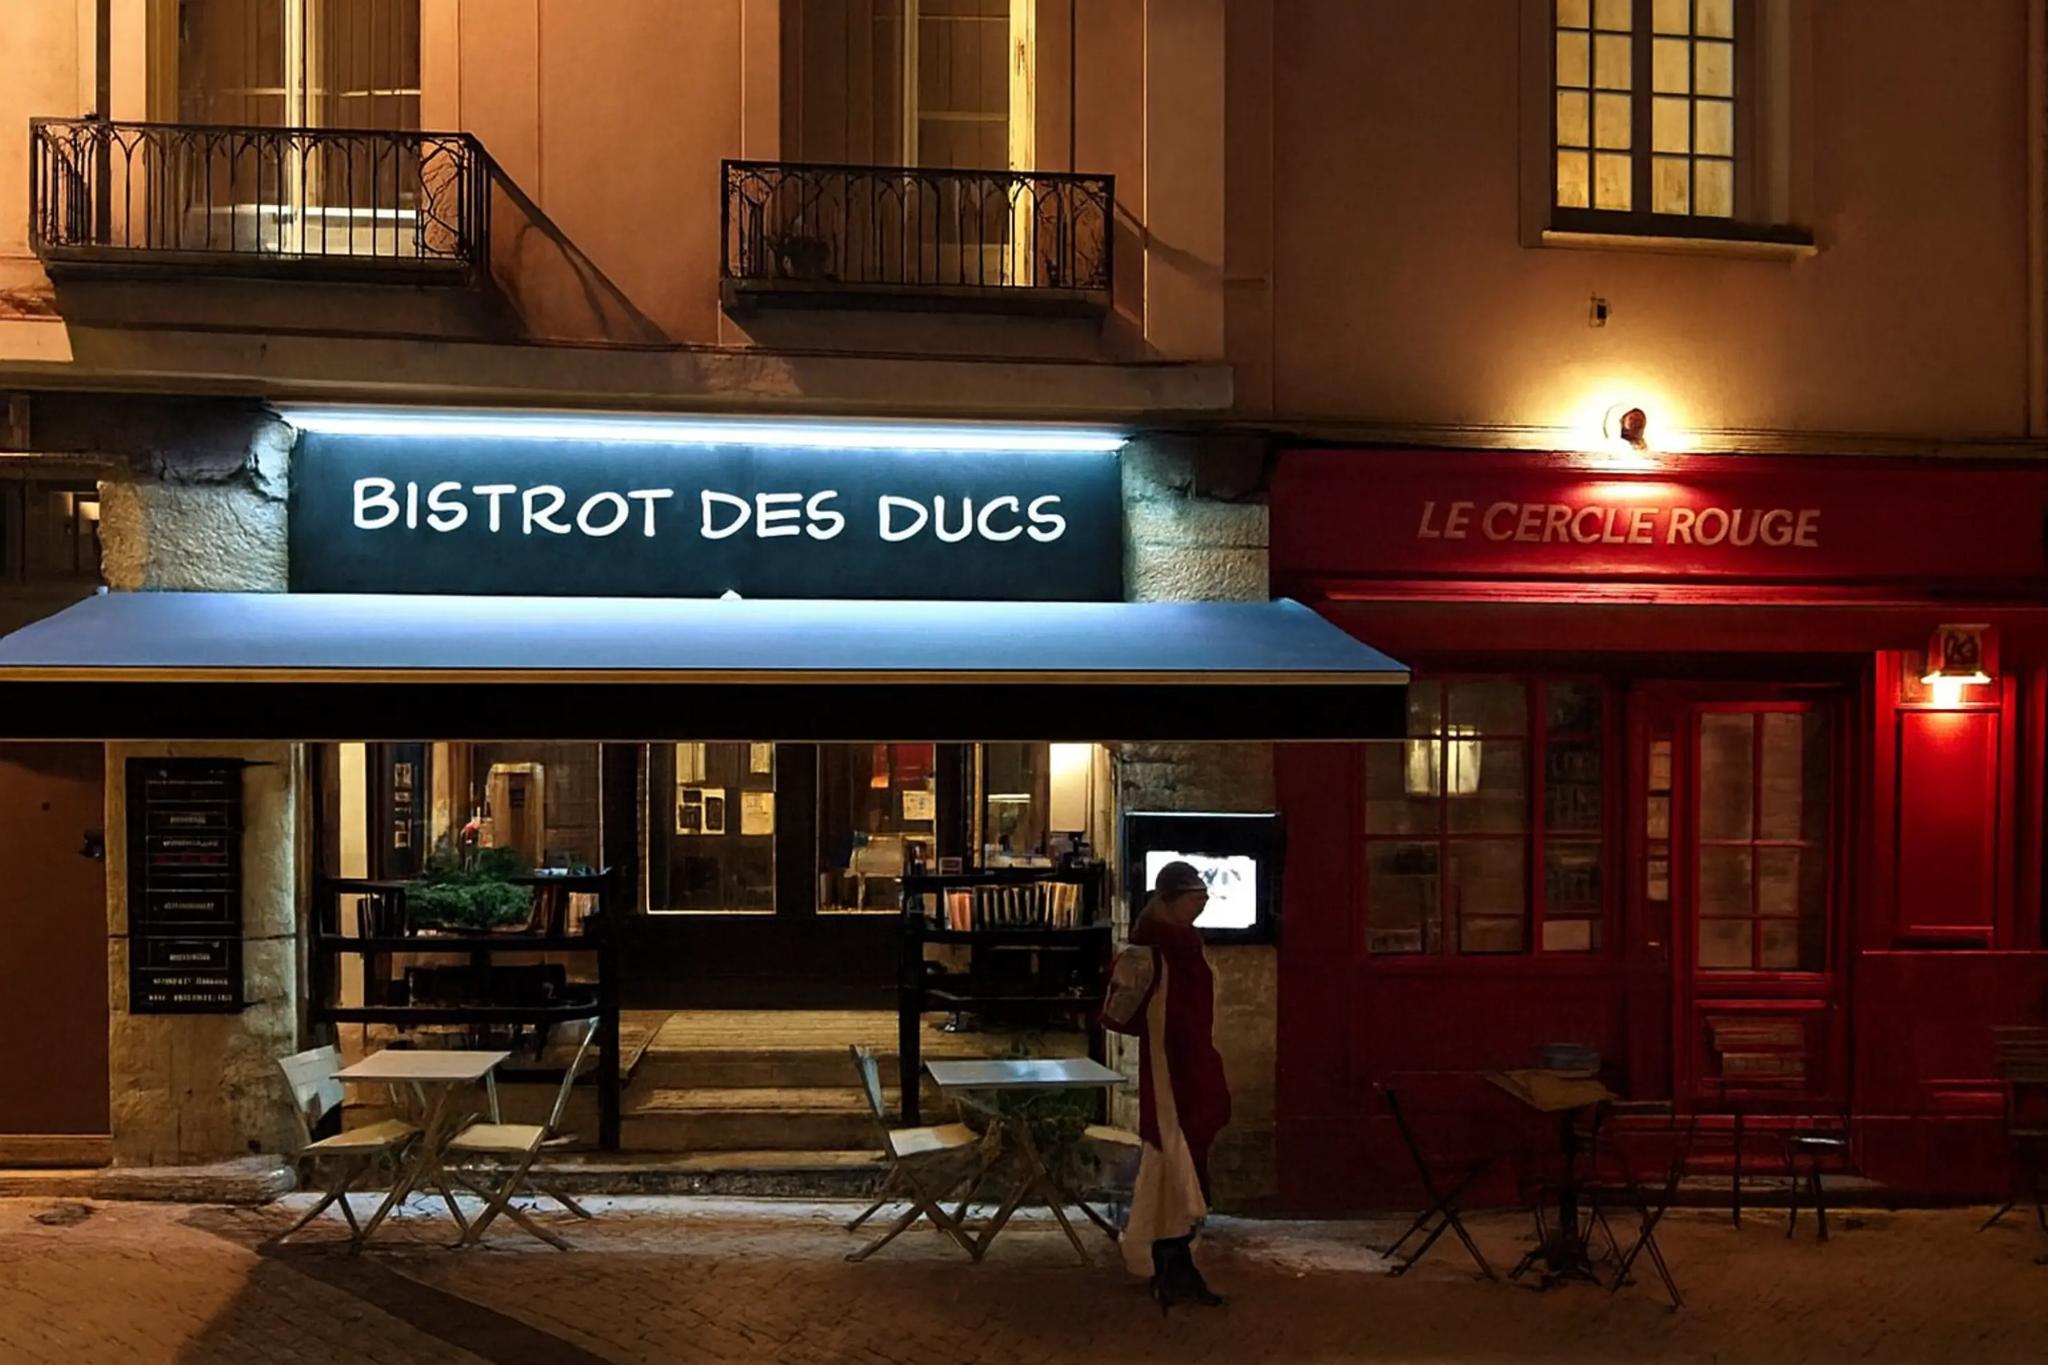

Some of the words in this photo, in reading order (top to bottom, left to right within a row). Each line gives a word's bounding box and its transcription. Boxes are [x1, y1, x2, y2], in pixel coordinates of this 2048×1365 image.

[353, 477, 673, 538] BISTROT
[700, 489, 846, 541] DES
[878, 494, 1067, 542] DUCS
[1417, 501, 1476, 539] LE
[1483, 502, 1660, 545] CERCLE
[1666, 508, 1821, 547] ROUGE
